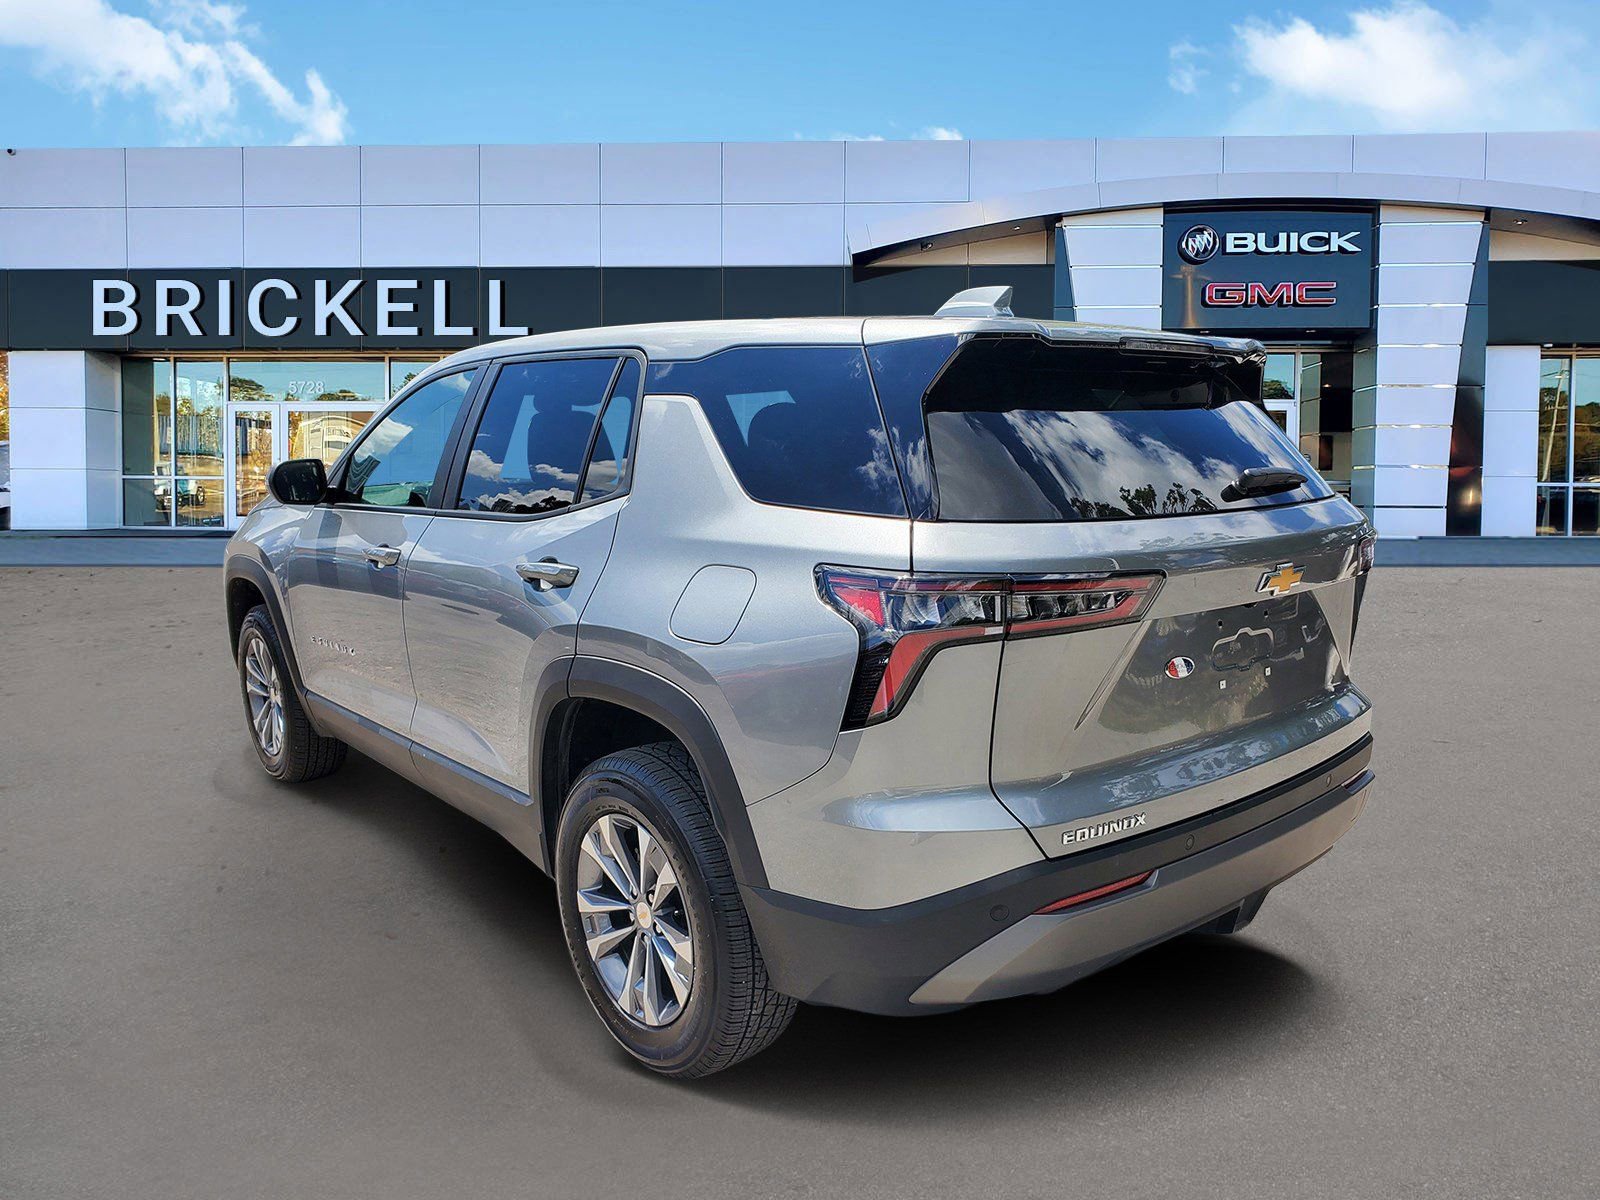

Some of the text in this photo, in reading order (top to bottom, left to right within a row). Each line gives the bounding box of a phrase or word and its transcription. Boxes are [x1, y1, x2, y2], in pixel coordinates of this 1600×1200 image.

[1225, 231, 1362, 254] BUICK
[1205, 281, 1337, 305] GMC
[92, 278, 530, 337] BRICKELL
[289, 381, 325, 394] 5728
[1062, 812, 1146, 845] EQUINOX
